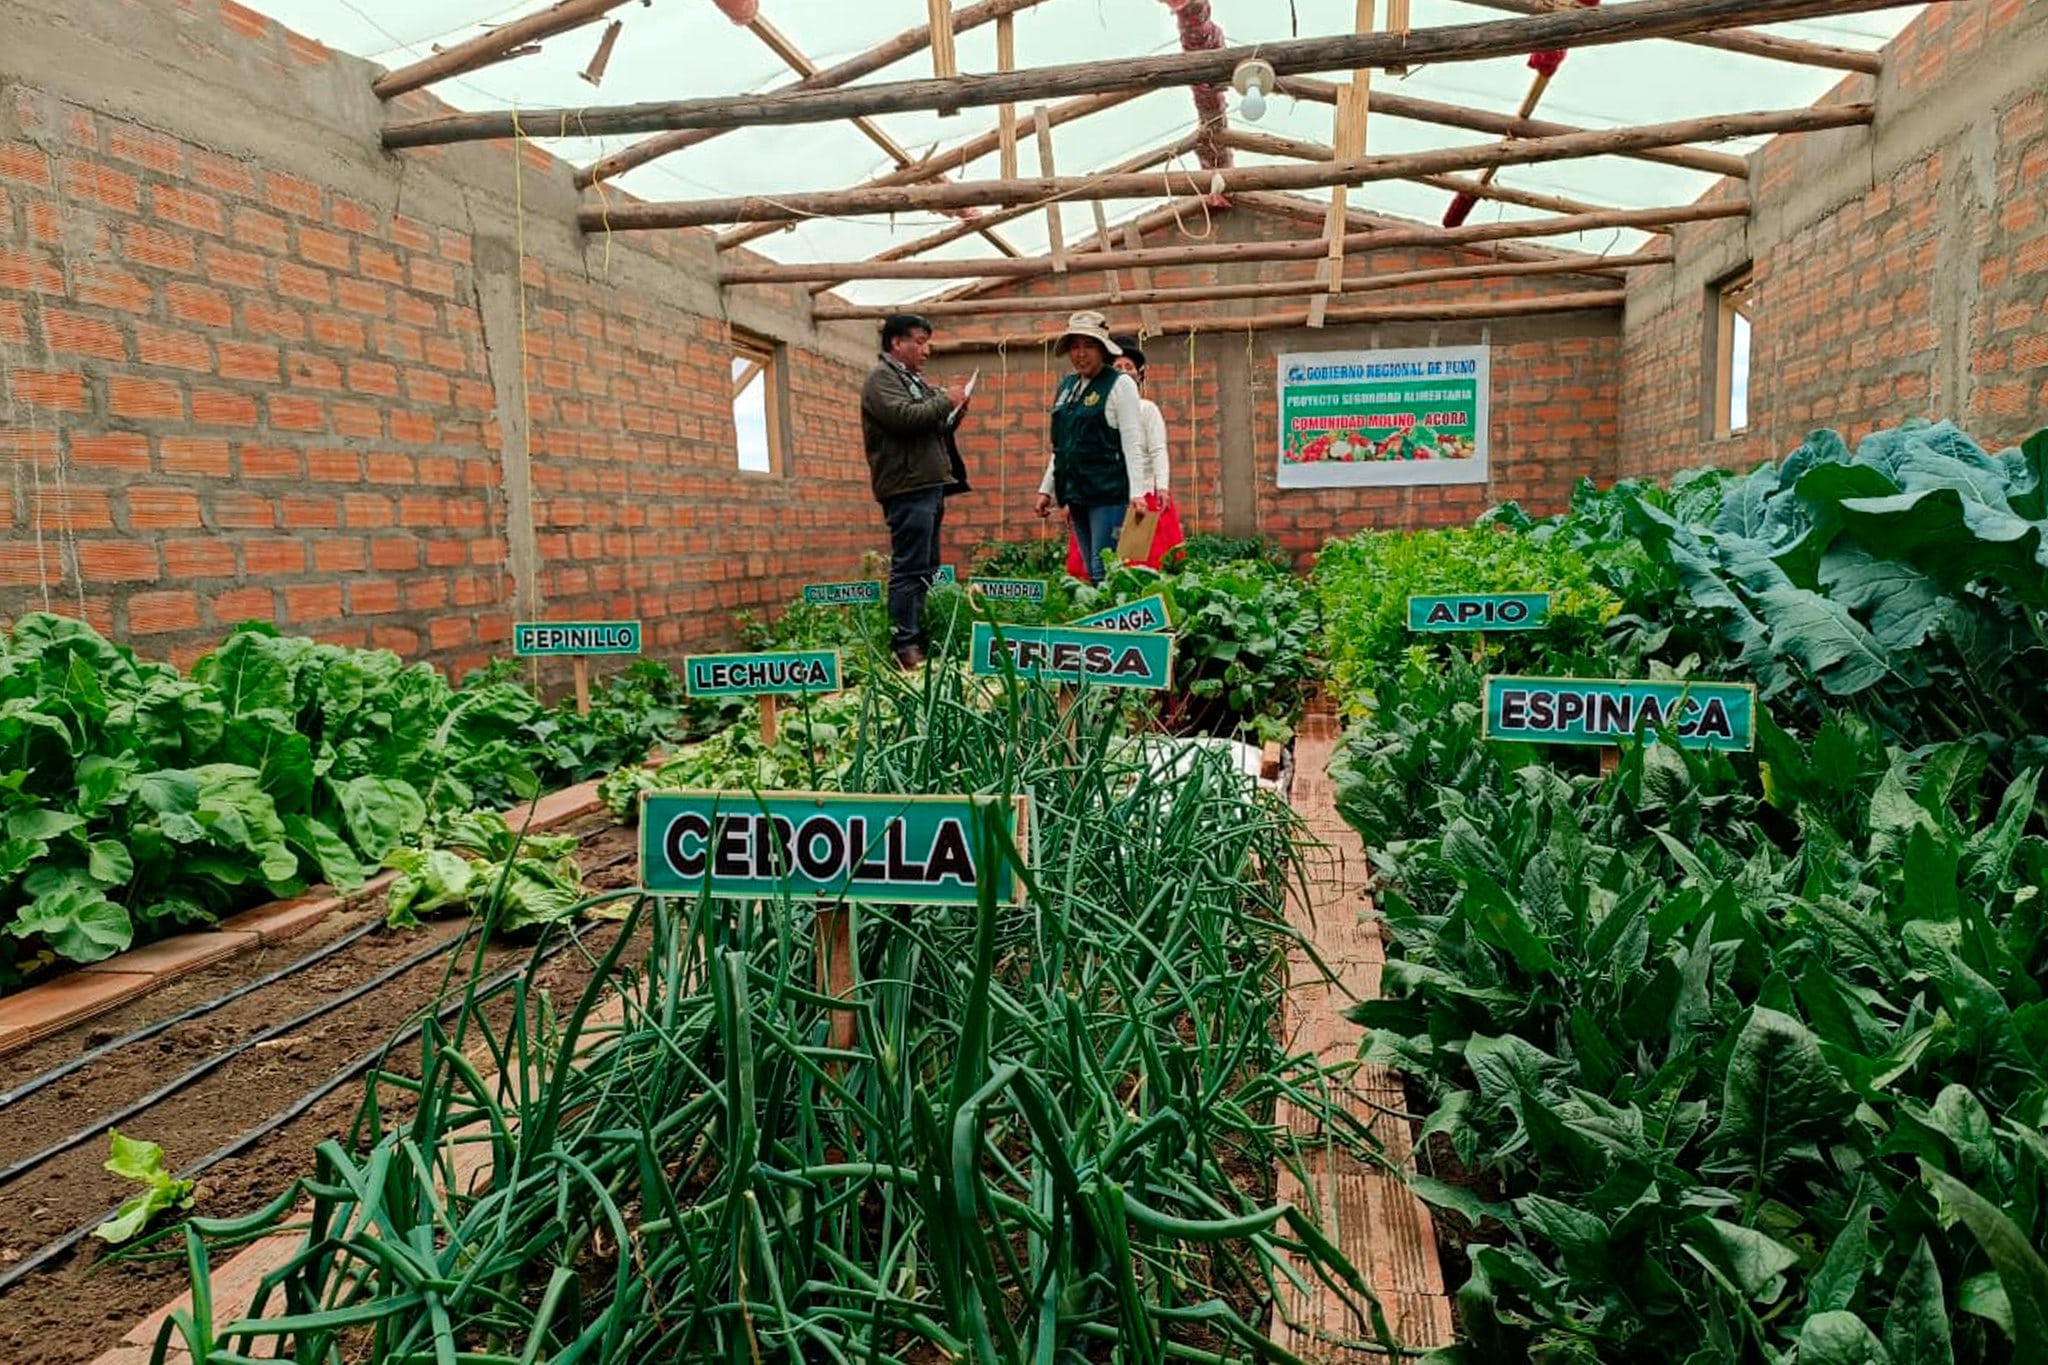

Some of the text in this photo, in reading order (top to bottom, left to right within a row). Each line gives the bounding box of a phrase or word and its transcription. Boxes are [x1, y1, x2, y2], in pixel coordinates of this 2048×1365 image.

[1307, 359, 1475, 380] GOBIERNO REGIONAL DE PUNO
[1287, 389, 1471, 407] PROYECTO SEGURIDAD ALIMENTARIA
[1293, 415, 1364, 430] COMUNIDAD
[1368, 413, 1415, 428] MOLINO
[1425, 411, 1466, 426] ACORA
[979, 583, 1040, 597] ANAHORIA
[1426, 599, 1527, 624] APIO
[522, 628, 632, 648] PEPINILLO
[695, 660, 828, 689] LECHUGA
[666, 812, 977, 884] CEBOLLA
